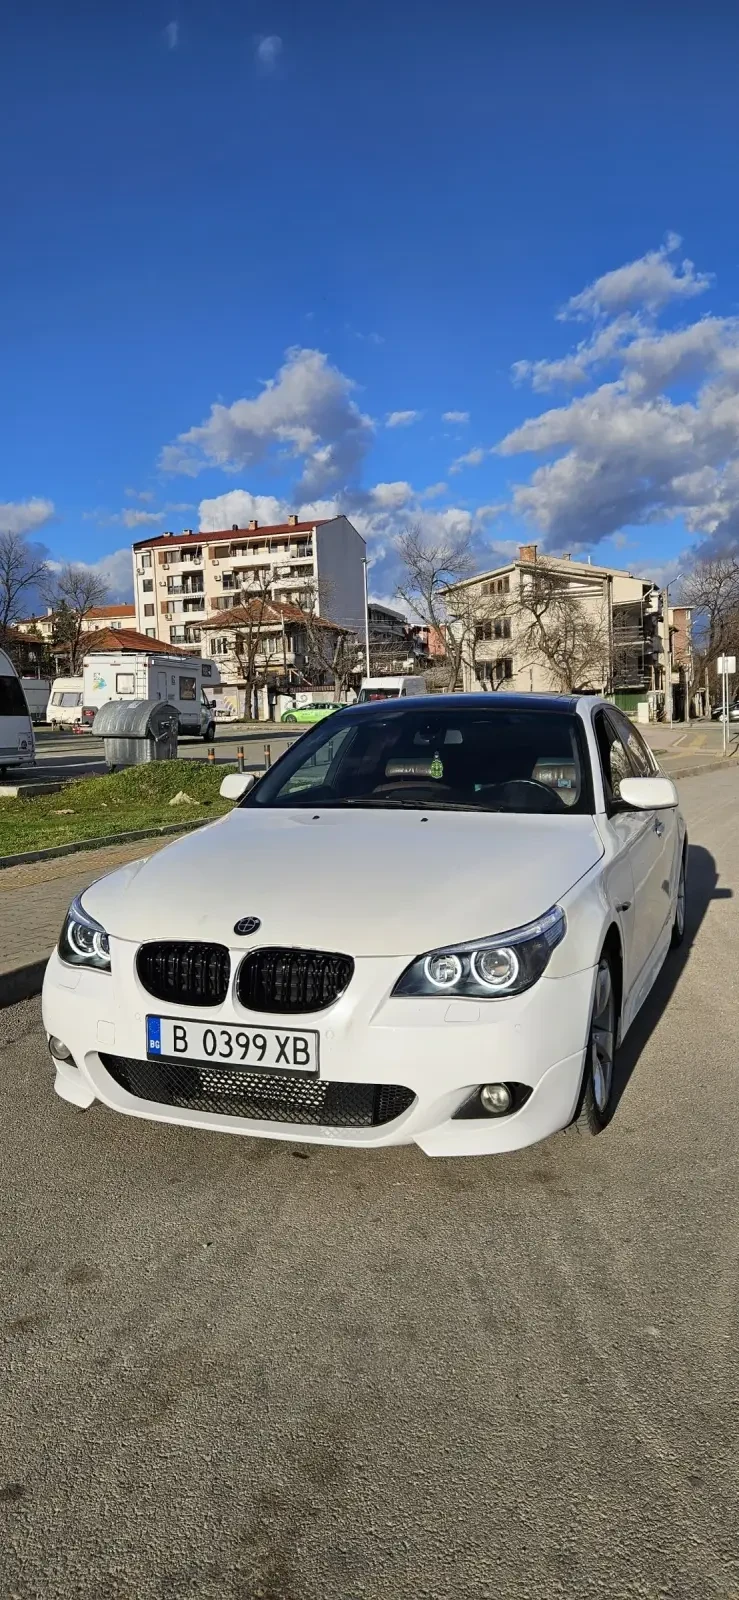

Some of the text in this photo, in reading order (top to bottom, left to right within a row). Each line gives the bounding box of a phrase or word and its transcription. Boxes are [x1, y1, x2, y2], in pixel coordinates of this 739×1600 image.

[149, 1040, 160, 1049] BG
[173, 1025, 311, 1066] B 0399 XB
